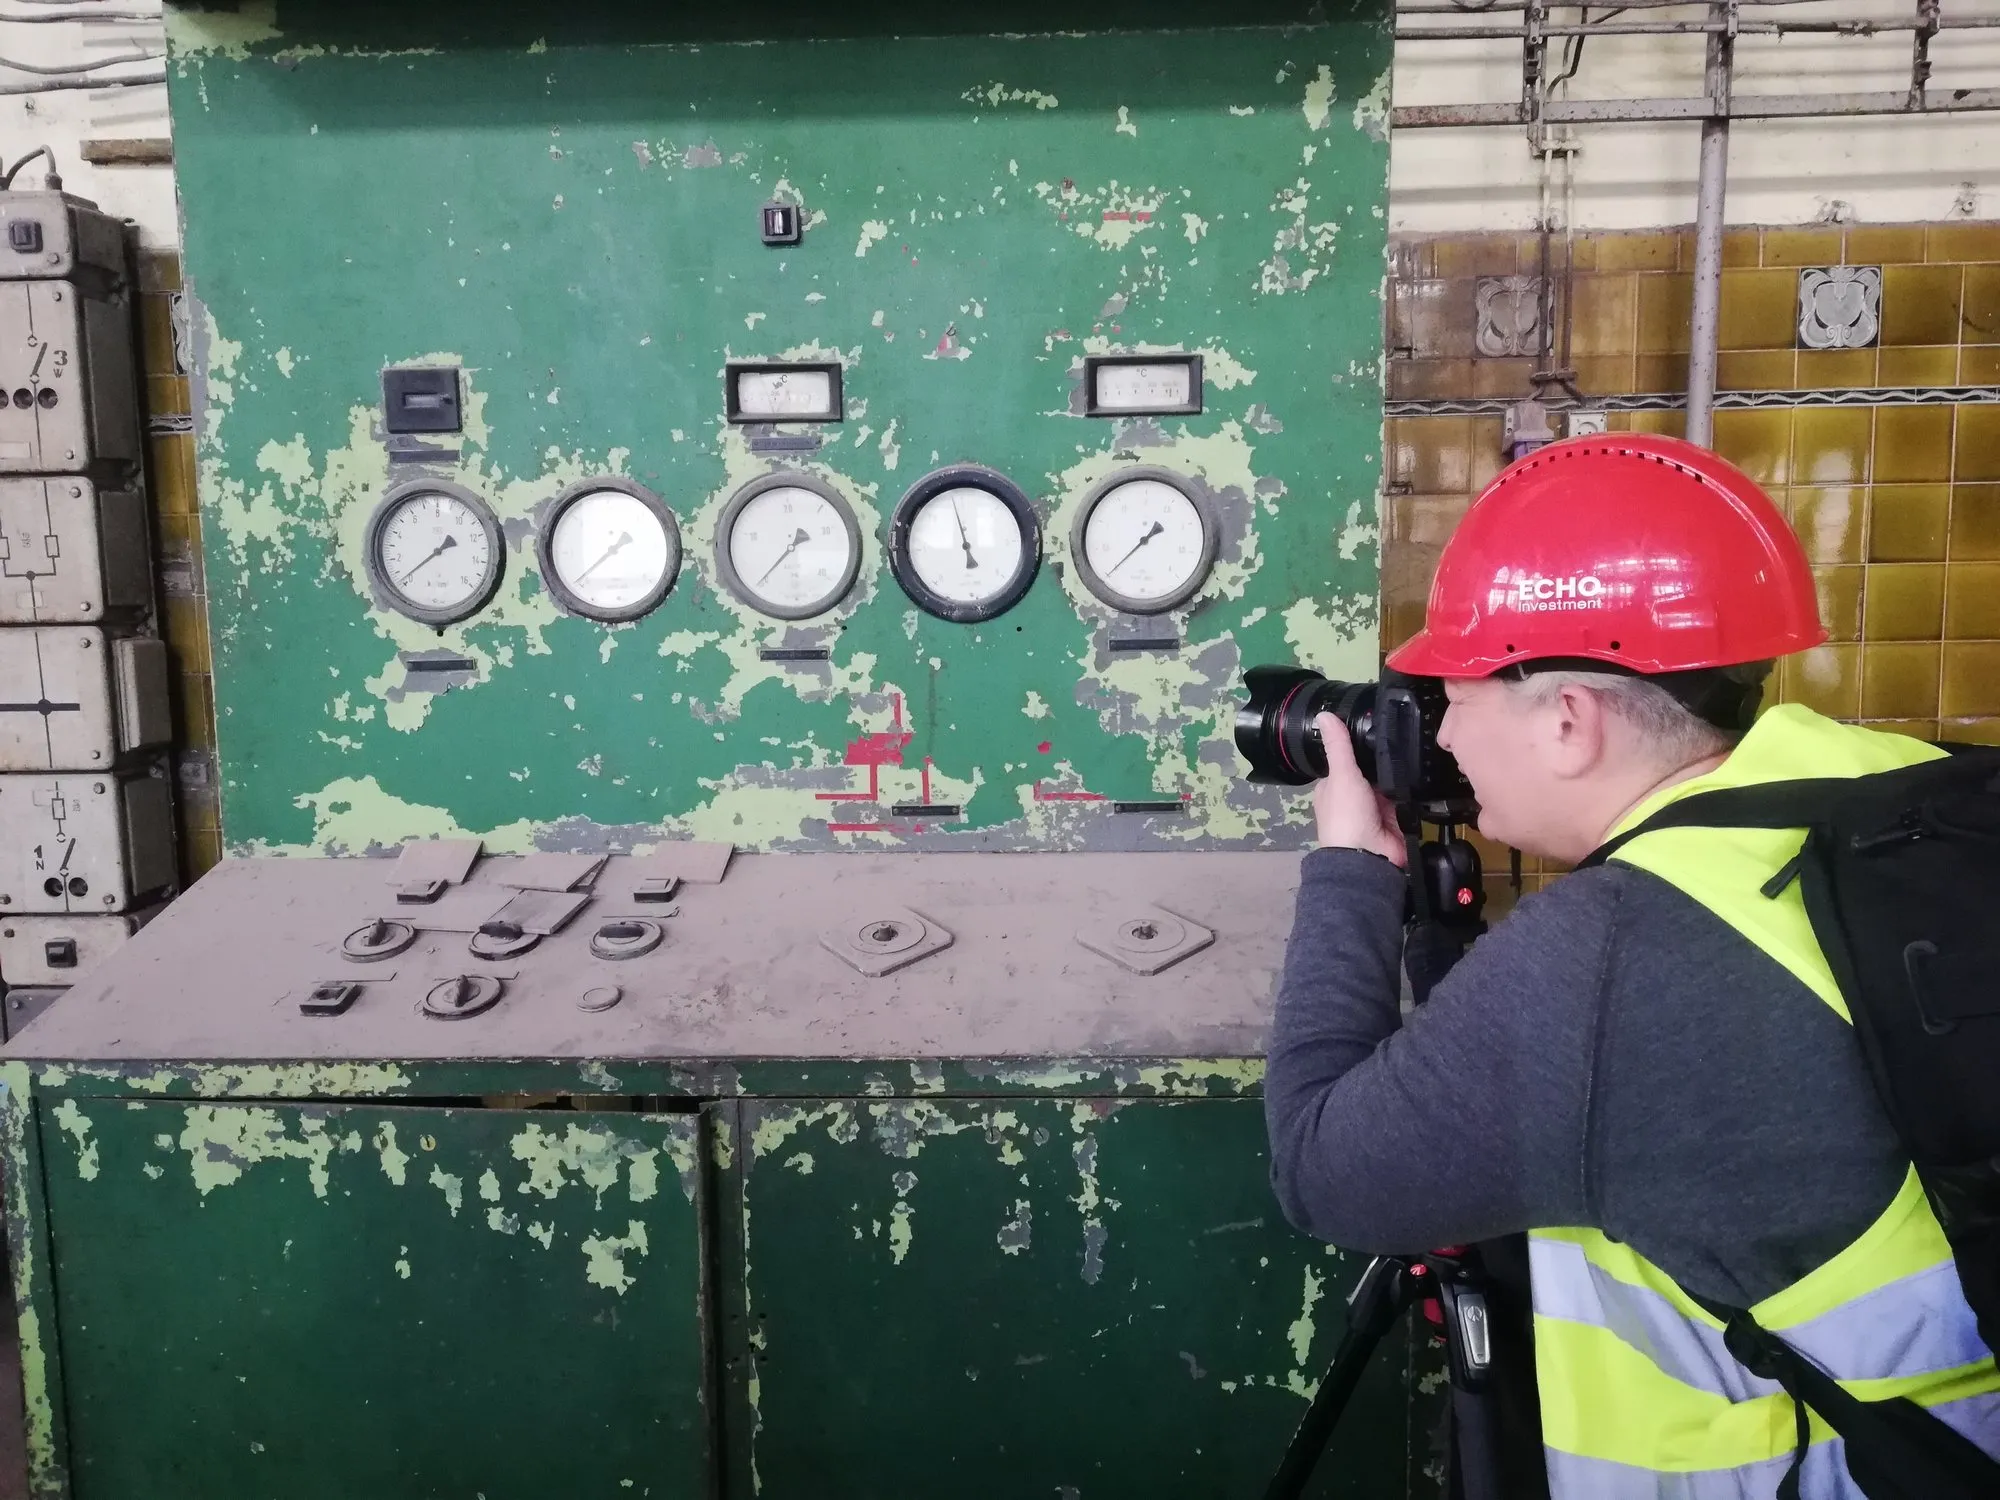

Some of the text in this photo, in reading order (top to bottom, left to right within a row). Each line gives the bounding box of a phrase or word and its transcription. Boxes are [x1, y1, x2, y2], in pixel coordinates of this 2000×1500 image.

[53, 349, 69, 366] 3
[435, 509, 440, 518] 8
[412, 515, 418, 524] 6
[455, 516, 463, 525] 10
[469, 533, 478, 543] 12
[396, 554, 402, 562] 2
[472, 555, 480, 564] 14
[460, 575, 469, 584] 16
[1519, 576, 1602, 600] ECHO
[33, 844, 43, 859] 1
[35, 859, 45, 871] N
